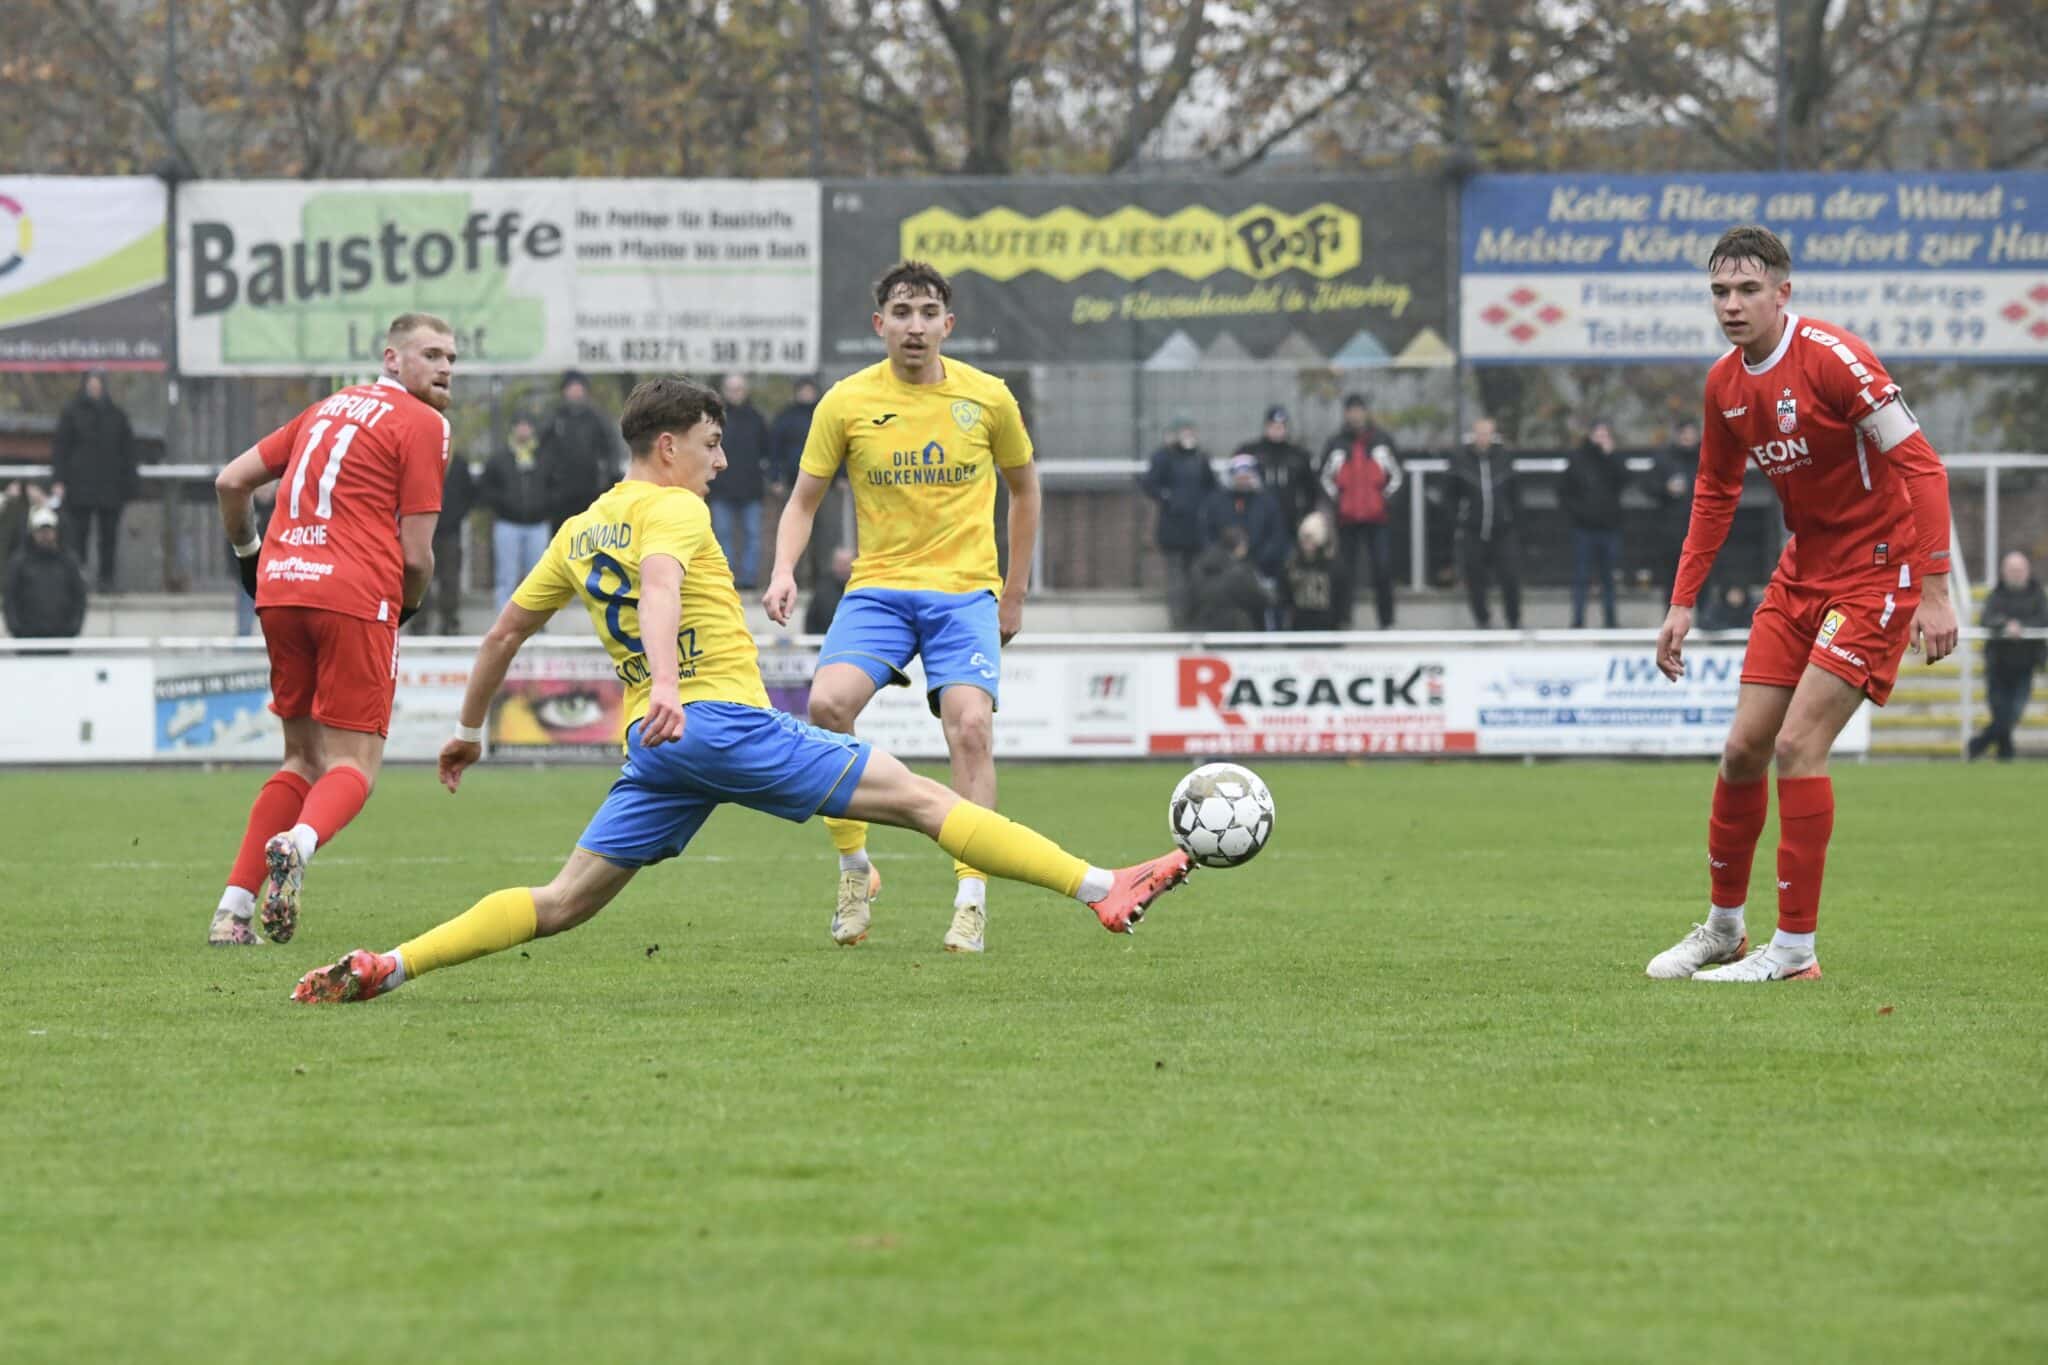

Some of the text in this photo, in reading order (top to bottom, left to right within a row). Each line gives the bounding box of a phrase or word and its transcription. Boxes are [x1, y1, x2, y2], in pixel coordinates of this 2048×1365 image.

[1549, 186, 1650, 221] Keine
[1659, 184, 1758, 221] Fliese
[1765, 193, 1815, 220] an
[1822, 186, 1889, 220] der
[1897, 184, 2004, 220] Wand
[191, 211, 562, 317] Baustoffe
[1474, 227, 1613, 264] Meister
[1801, 225, 1911, 266] sofort
[1920, 233, 1983, 267] zur
[1586, 320, 1701, 346] Telefon
[316, 394, 395, 428] ERFURT
[290, 418, 358, 519] 11
[893, 451, 919, 466] DIE
[1750, 436, 1809, 466] EON
[279, 524, 328, 547] LERCHE
[586, 552, 645, 653] 8
[1178, 658, 1422, 725] RASACK
